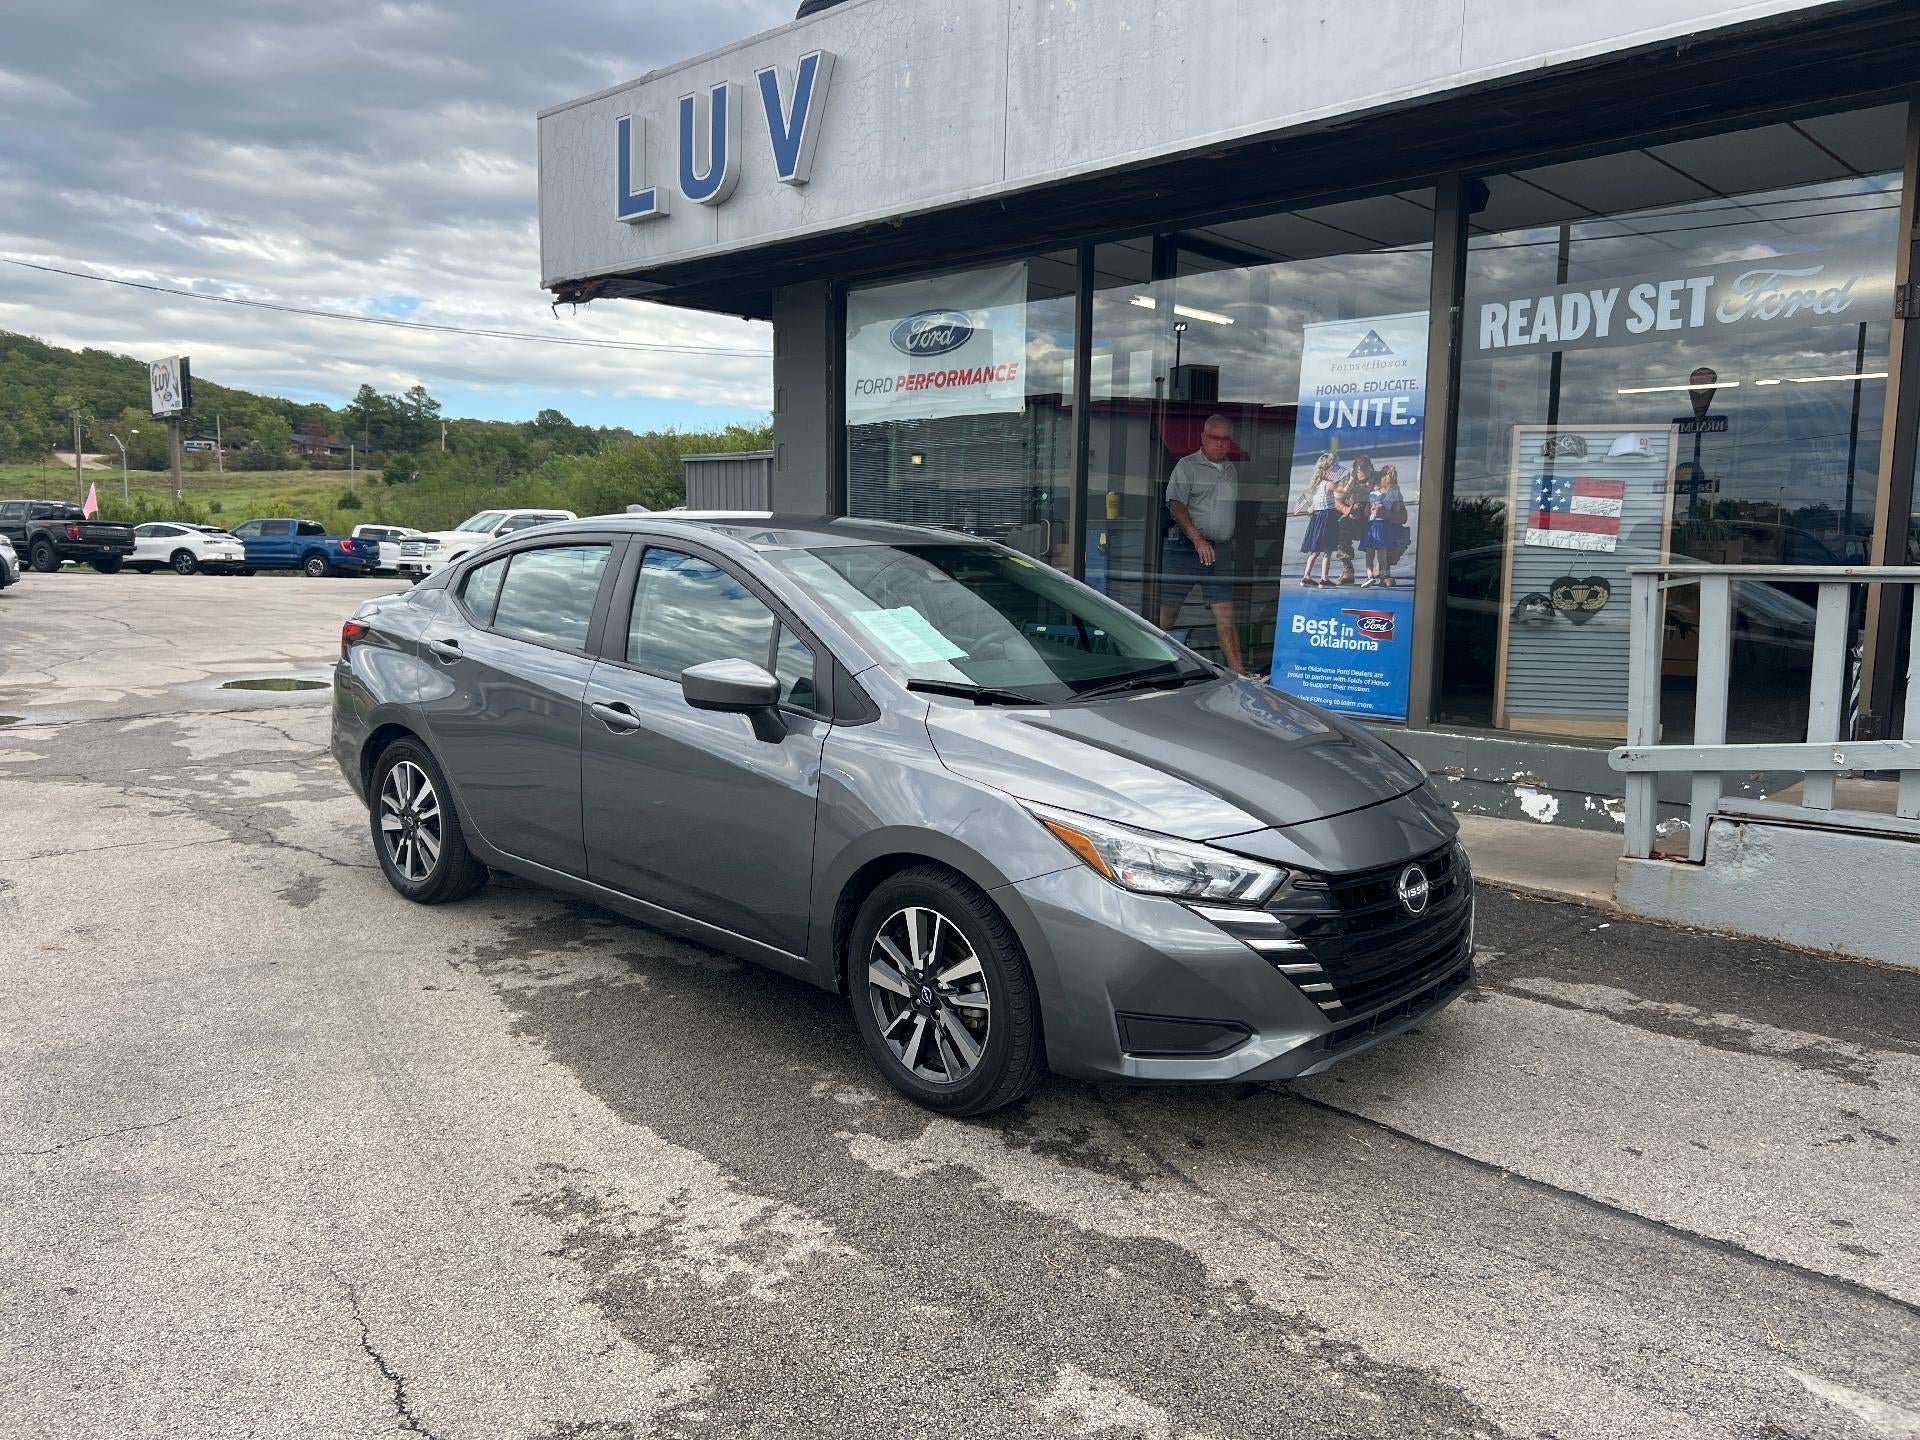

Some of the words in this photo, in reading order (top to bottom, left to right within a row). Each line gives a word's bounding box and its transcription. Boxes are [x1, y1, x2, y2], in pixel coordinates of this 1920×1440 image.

[616, 49, 830, 223] LUV
[1479, 287, 1621, 350] READY
[1625, 276, 1715, 335] SET
[1715, 264, 1859, 324] Ford
[905, 319, 957, 350] Ford
[854, 376, 893, 397] FORD
[895, 362, 1019, 392] PERFORMANCE
[1316, 382, 1360, 395] HONOR.
[1363, 379, 1419, 393] EDUCATE.
[1313, 396, 1417, 430] UNITE.
[1291, 614, 1338, 635] Best
[1340, 623, 1354, 637] in
[1363, 619, 1388, 630] Ford
[1309, 634, 1379, 651] Oklahoma
[1287, 672, 1303, 680] proud
[1311, 674, 1332, 682] partner
[1371, 679, 1391, 687] Honor
[1308, 665, 1335, 675] Oklahoma
[1351, 669, 1372, 678] Dealers
[1374, 671, 1384, 679] are
[1309, 682, 1332, 690] support
[1341, 699, 1356, 707] learn
[1399, 880, 1429, 900] NISSAN
